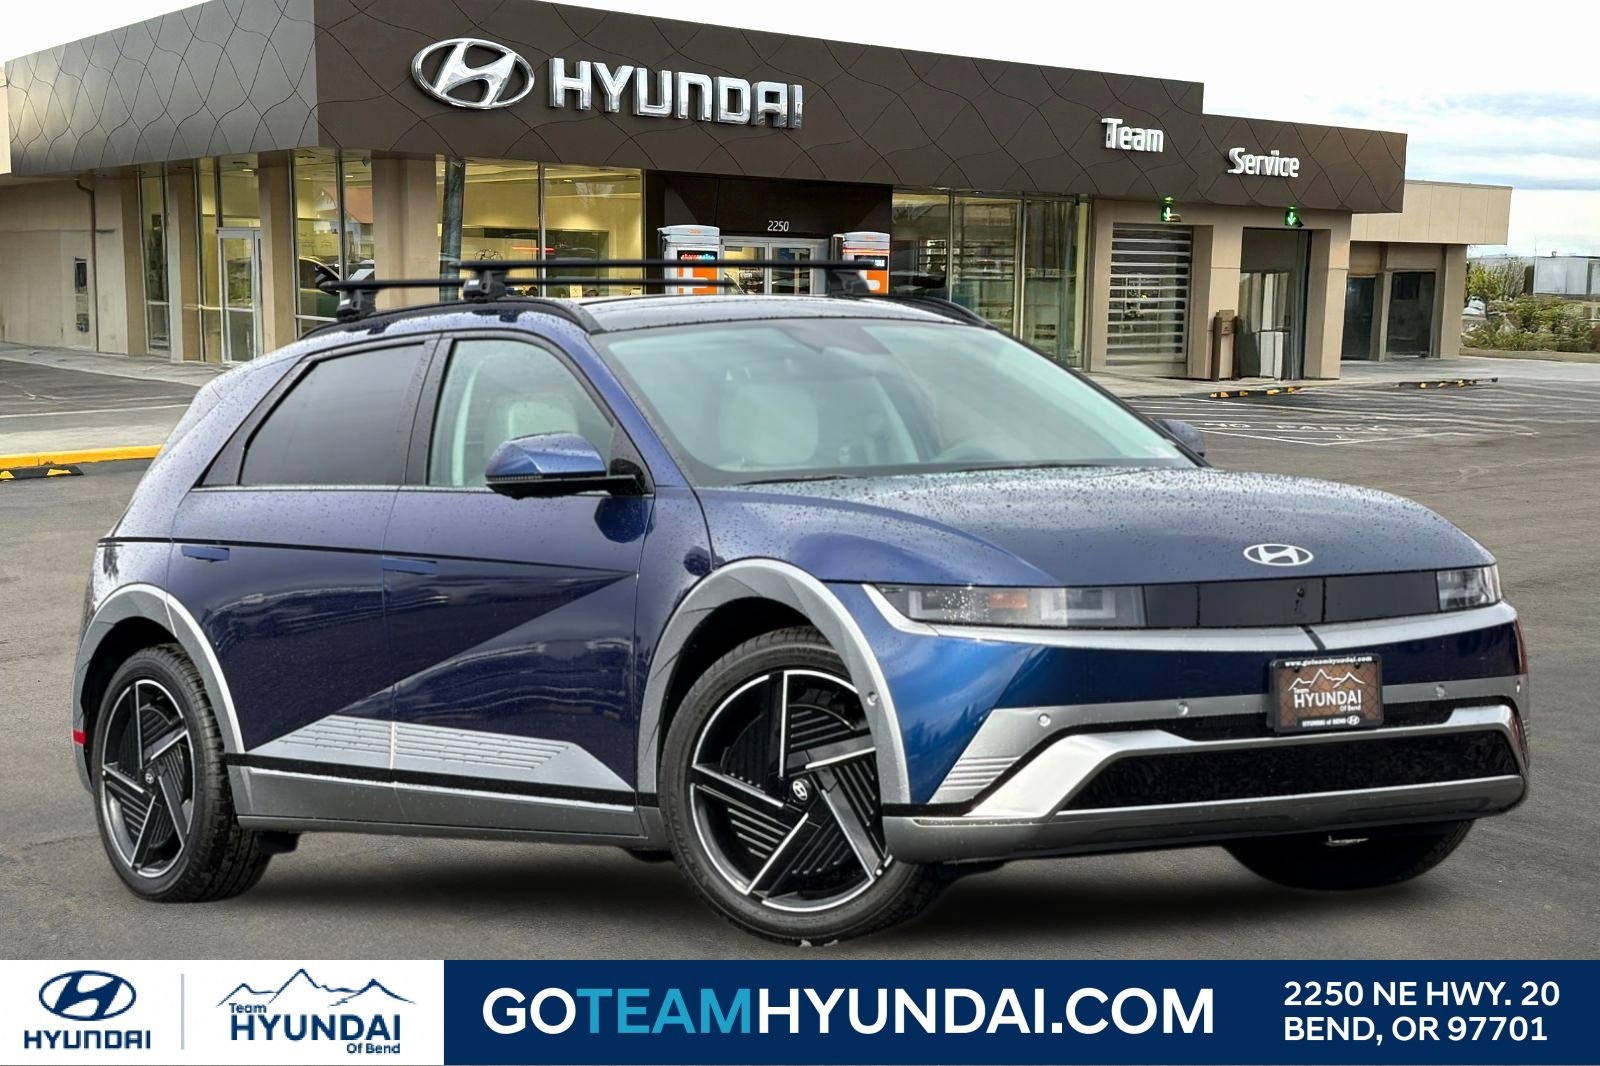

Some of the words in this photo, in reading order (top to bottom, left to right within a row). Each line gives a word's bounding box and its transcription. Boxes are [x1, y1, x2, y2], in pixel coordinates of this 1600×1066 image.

[548, 57, 803, 129] HYUNDAI
[1101, 117, 1164, 152] Team
[1227, 147, 1300, 178] Service
[767, 220, 790, 232] 2250
[1293, 689, 1362, 709] HYUNDAI
